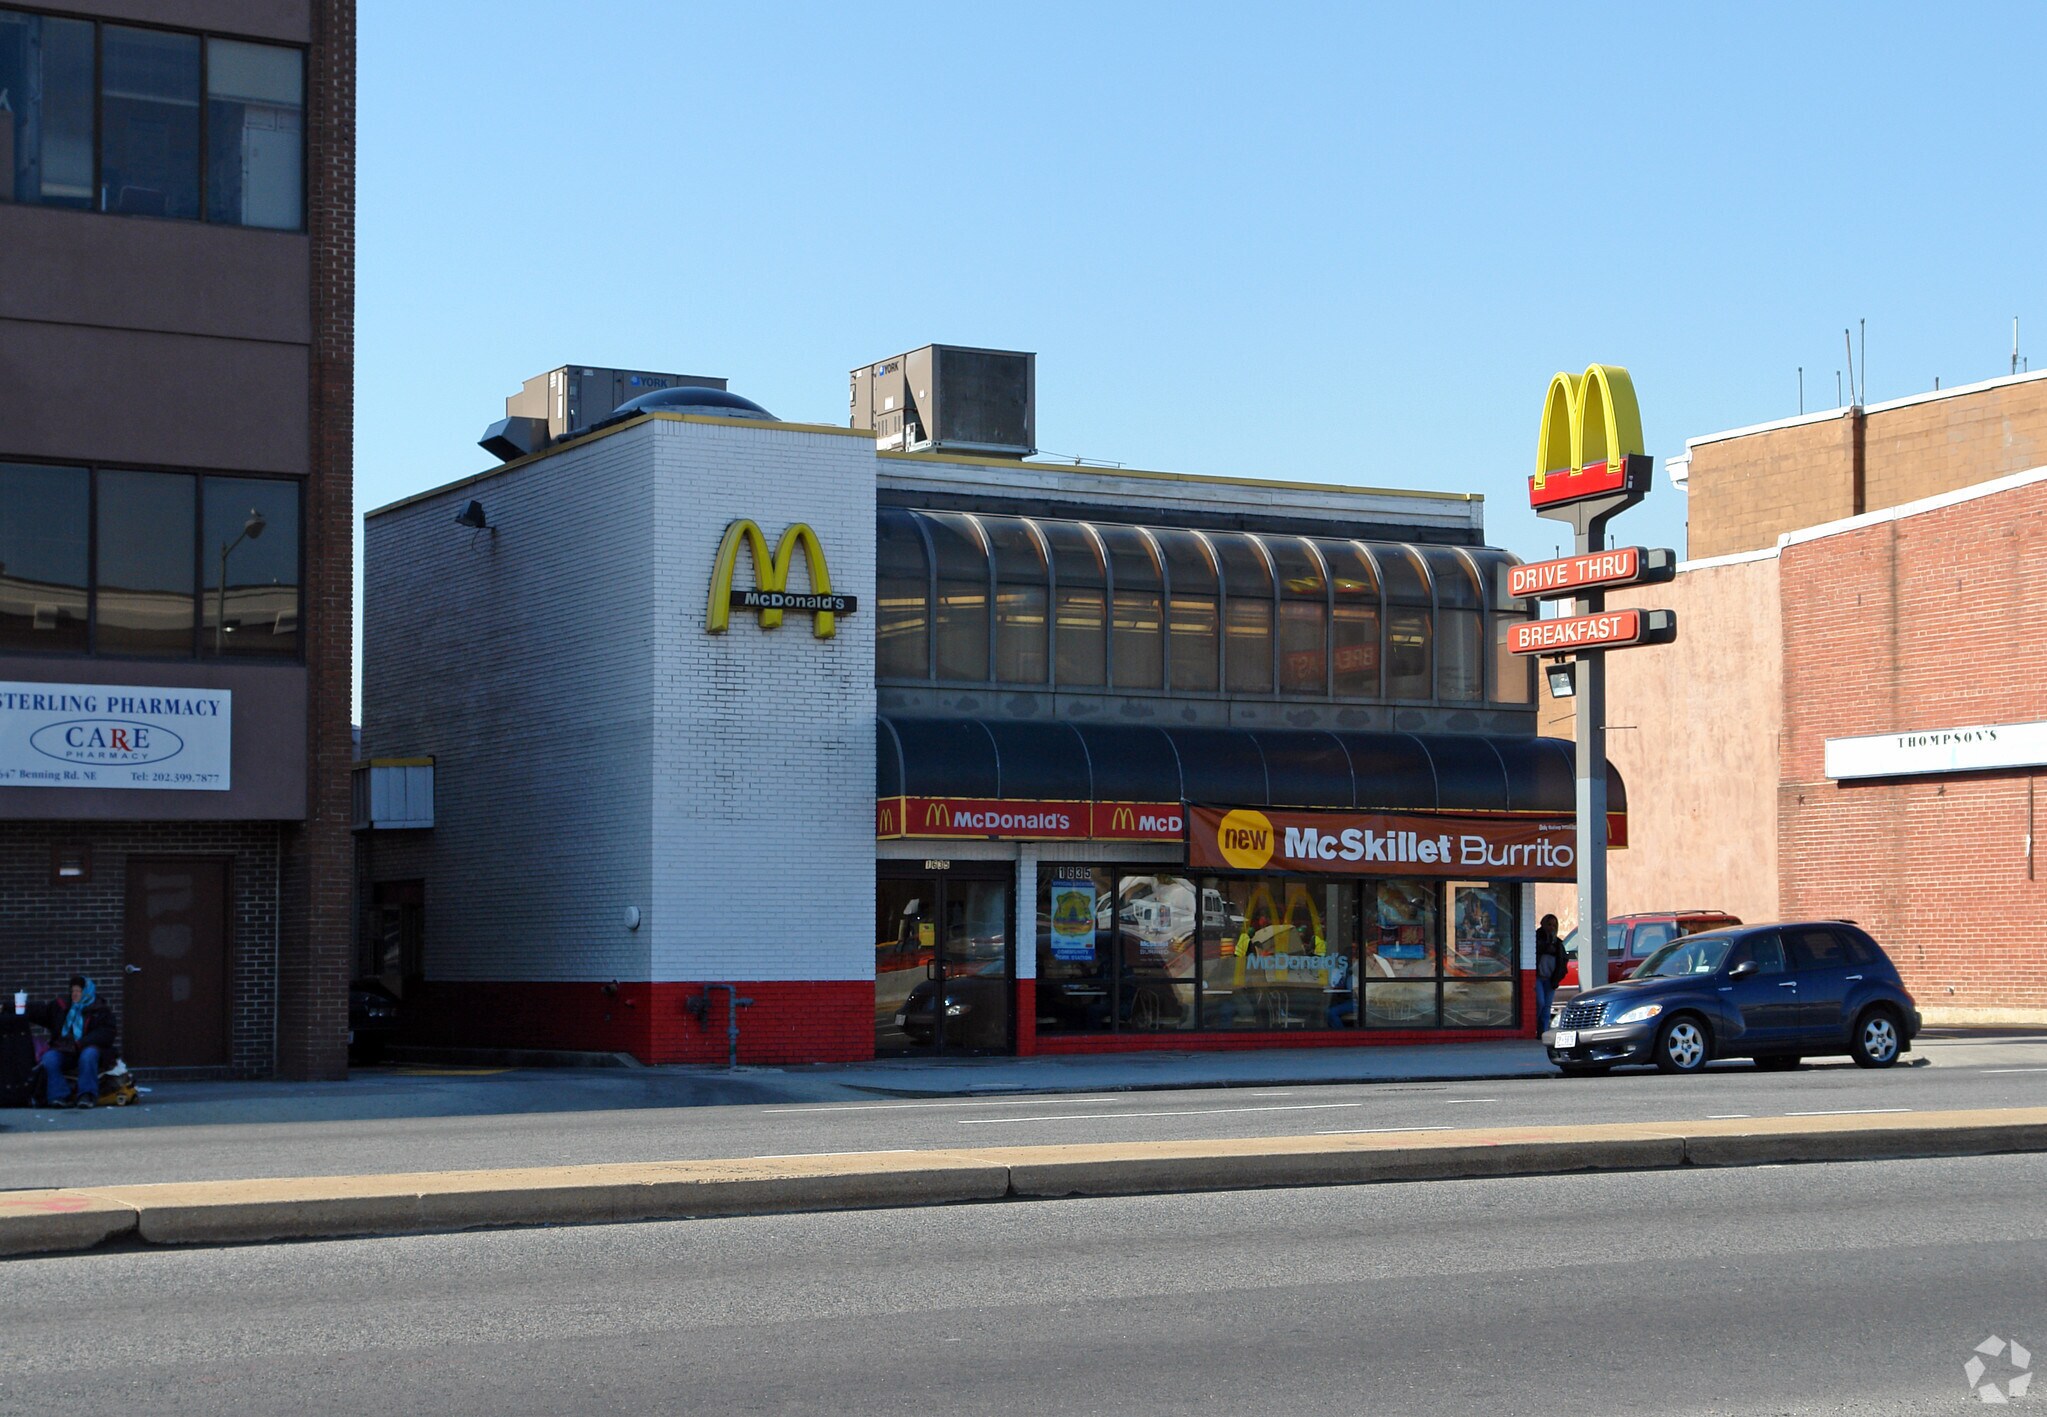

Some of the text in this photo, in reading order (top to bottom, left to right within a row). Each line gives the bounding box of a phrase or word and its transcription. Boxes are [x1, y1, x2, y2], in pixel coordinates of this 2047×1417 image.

[883, 361, 899, 375] YORK
[640, 376, 668, 388] YORK
[1513, 553, 1628, 592] DRIVE THRU
[744, 593, 845, 610] McDonald's
[1519, 616, 1621, 648] BREAKFAST
[107, 696, 220, 716] PHARMACY
[1898, 730, 1997, 748] THOMPSON'S
[66, 750, 149, 760] PHARMACY
[19, 770, 60, 782] Benning
[63, 770, 80, 780] Rd.
[83, 771, 97, 780] NE
[130, 771, 149, 782] Tel:
[152, 773, 220, 783] 202.399.7877
[953, 812, 1070, 830] McDonald's
[1138, 816, 1183, 832] McD
[1224, 827, 1268, 850] new
[1284, 827, 1574, 868] McSkillet Burrito
[925, 860, 950, 870] 1635
[1059, 866, 1092, 879] 1635
[1246, 953, 1348, 970] McDonald's
